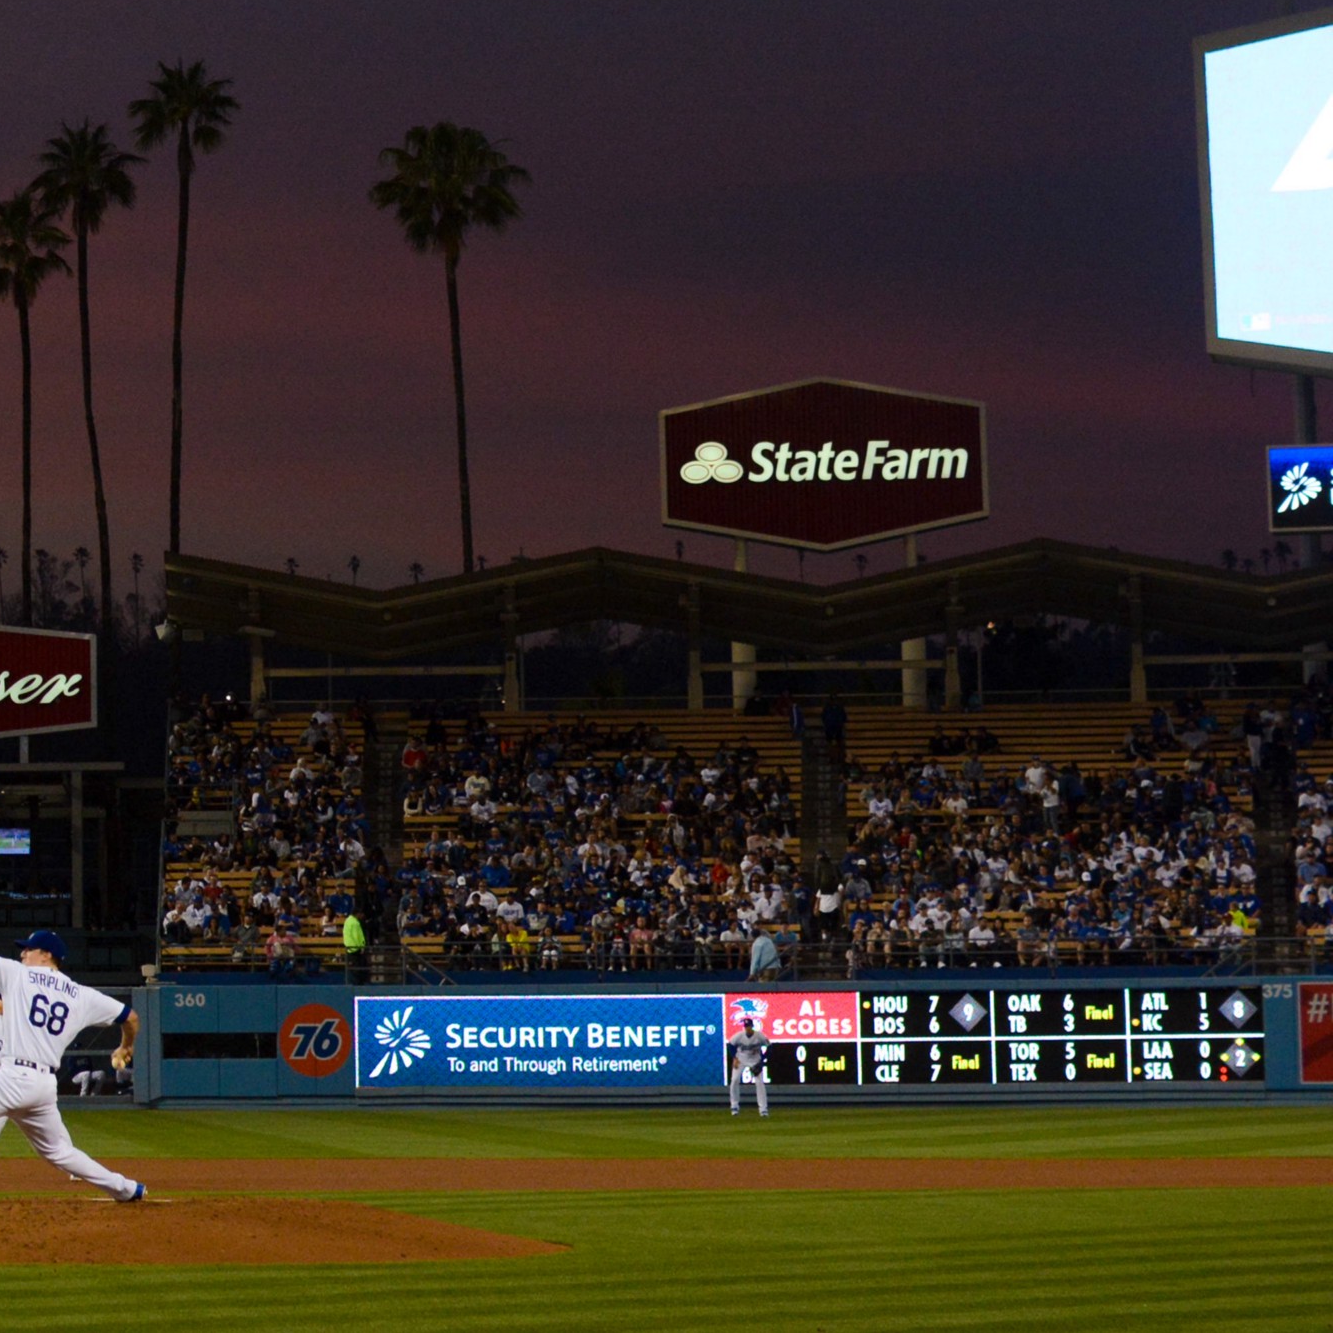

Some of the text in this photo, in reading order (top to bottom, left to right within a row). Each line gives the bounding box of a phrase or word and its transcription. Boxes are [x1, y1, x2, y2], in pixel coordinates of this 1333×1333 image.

[748, 440, 969, 483] State Farm
[29, 971, 78, 998] STRIPLING
[1262, 984, 1293, 998] 375
[174, 993, 206, 1008] 360
[799, 1000, 825, 1016] AL
[873, 996, 973, 1021] HOU 7 9
[1007, 995, 1113, 1020] OAK 6 Final
[1141, 993, 1244, 1018] ATL 1 8
[29, 993, 69, 1036] 68
[873, 1016, 940, 1034] BOS 6
[1008, 1014, 1074, 1033] TB 3
[1142, 1014, 1209, 1031] KC 5
[446, 1023, 580, 1049] SECURITY
[772, 1018, 852, 1035] SCORES
[290, 1018, 339, 1059] 76
[796, 1046, 845, 1072] 0 Final
[874, 1044, 980, 1070] MIN 6 Final
[1009, 1042, 1115, 1069] TOR 5 Final
[1143, 1042, 1246, 1067] LAA 0 2
[447, 1057, 465, 1072] To
[470, 1057, 498, 1072] and
[503, 1057, 566, 1075] Through
[798, 1066, 805, 1083] 1
[875, 1065, 941, 1082] CLE 7
[1010, 1064, 1076, 1081] TEX 0
[1144, 1062, 1211, 1080] SEA 0
